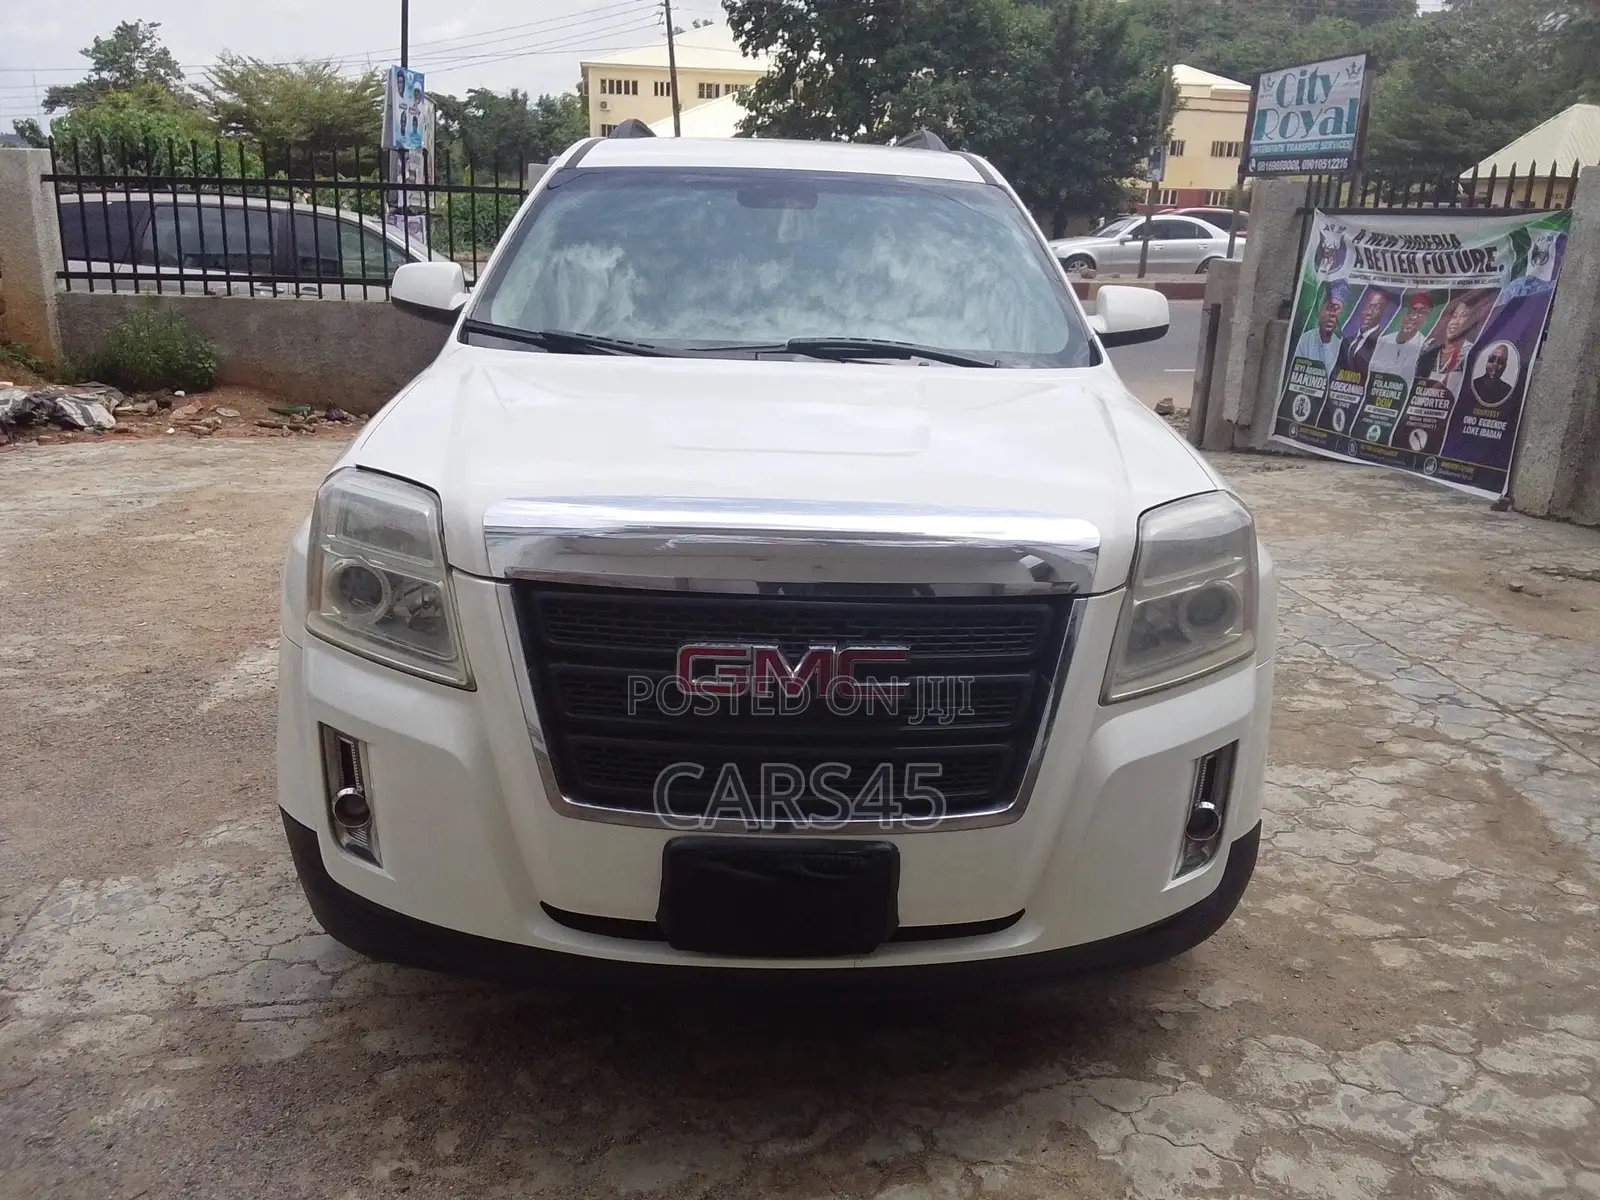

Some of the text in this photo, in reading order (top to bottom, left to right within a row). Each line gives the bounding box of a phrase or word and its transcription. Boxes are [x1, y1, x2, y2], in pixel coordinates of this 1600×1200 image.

[1276, 66, 1340, 108] City
[1253, 98, 1360, 141] Royal
[1286, 142, 1320, 152] TRANSPORT
[1352, 229, 1366, 244] A
[1366, 232, 1399, 248] NEW
[1353, 246, 1364, 269] A
[1363, 246, 1420, 274] BETTER
[1290, 371, 1328, 390] MAKINDE
[1479, 428, 1503, 440] IBADAN
[676, 642, 911, 698] GMC
